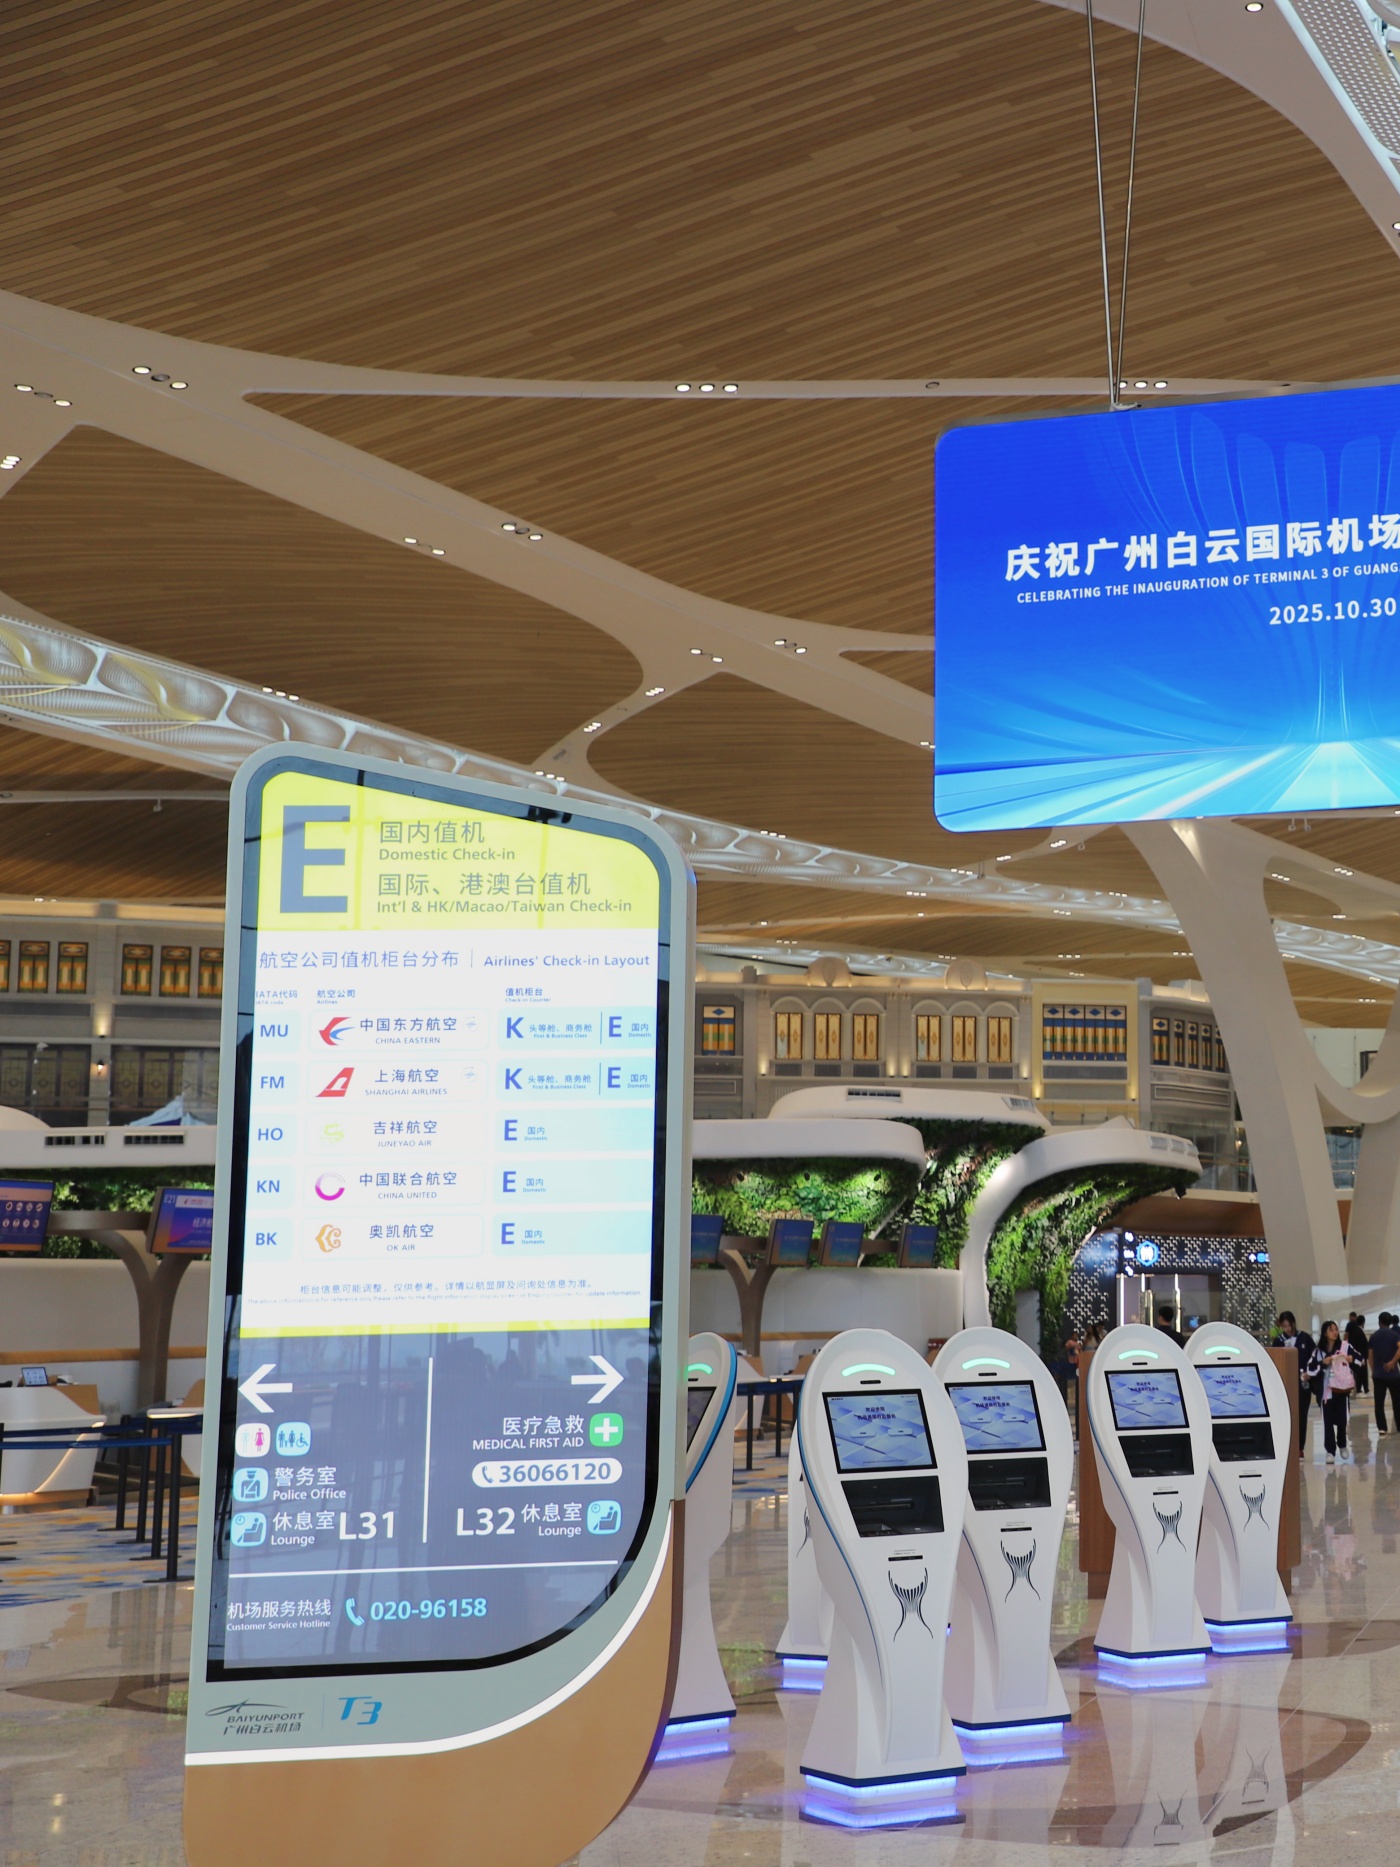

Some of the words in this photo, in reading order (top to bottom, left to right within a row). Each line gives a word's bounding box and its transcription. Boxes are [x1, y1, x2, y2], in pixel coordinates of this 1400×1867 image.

[1017, 586, 1101, 603] CELEBRATING
[1105, 584, 1129, 596] THE
[1133, 576, 1228, 594] INAUGURATION
[1233, 574, 1250, 586] OF
[1254, 568, 1317, 584] TERMINAL
[1321, 568, 1328, 579] 3
[1332, 566, 1350, 577] OF
[1270, 597, 1397, 625] 2025.10.30
[380, 820, 485, 843] 国内值机
[280, 806, 350, 913] E
[380, 849, 448, 860] Domestic
[453, 848, 515, 860] Check-in
[378, 872, 591, 896] 国际、港澳台值机
[378, 901, 406, 912] Int'l
[412, 902, 421, 912] &
[428, 900, 564, 912] HK/Macao/Taiwan
[570, 900, 632, 912] Check-in
[259, 950, 459, 968] 航空公司值机柜台分布
[484, 956, 538, 966] Airlines'
[543, 956, 599, 966] Check-in
[604, 956, 650, 968] Layout
[256, 990, 298, 998] IATA代码
[317, 990, 356, 998] 航空公司
[506, 988, 543, 996] 值机柜台
[261, 1025, 289, 1037] MU
[360, 1018, 457, 1031] 中国东方航空
[507, 1017, 524, 1038] K
[529, 1024, 592, 1032] 头等舱、商务舱
[609, 1016, 622, 1037] E
[632, 1023, 649, 1032] 国内
[261, 1076, 284, 1088] FM
[375, 1069, 439, 1083] 上海航空
[505, 1068, 523, 1089] K
[528, 1075, 591, 1084] 头等舱、商务舱
[608, 1067, 621, 1088] E
[631, 1074, 648, 1082] 国内
[373, 1120, 437, 1134] 吉祥航空
[504, 1120, 518, 1141] E
[528, 1127, 545, 1135] 国内
[258, 1128, 283, 1140] HO
[360, 1172, 457, 1186] 中国联合航空
[503, 1171, 516, 1192] E
[526, 1178, 543, 1186] 国内
[257, 1180, 280, 1193] KN
[370, 1224, 434, 1239] 奥凯航空
[502, 1223, 515, 1244] E
[525, 1230, 542, 1238] 国内
[256, 1233, 277, 1245] BK
[503, 1415, 584, 1435] 医疗急救
[473, 1439, 526, 1450] MEDICAL
[530, 1438, 560, 1448] FIRST
[563, 1437, 584, 1447] AID
[274, 1466, 336, 1487] 警务室
[499, 1463, 611, 1483] 36066120
[273, 1490, 307, 1500] Police
[310, 1488, 346, 1499] Office
[273, 1510, 335, 1531] 休息室
[340, 1511, 394, 1540] L31
[457, 1507, 515, 1536] L32
[521, 1502, 582, 1523] 休息室
[539, 1526, 581, 1537] Lounge
[271, 1535, 315, 1546] Lounge
[227, 1599, 332, 1619] 机场服务热线
[370, 1598, 487, 1620] 020-96158
[226, 1622, 266, 1632] Customer
[268, 1621, 297, 1630] Service
[300, 1620, 330, 1629] Hotline
[339, 1696, 382, 1725] T3
[227, 1712, 304, 1723] BAIYUNPORT
[223, 1722, 301, 1735] 广州白云机场
